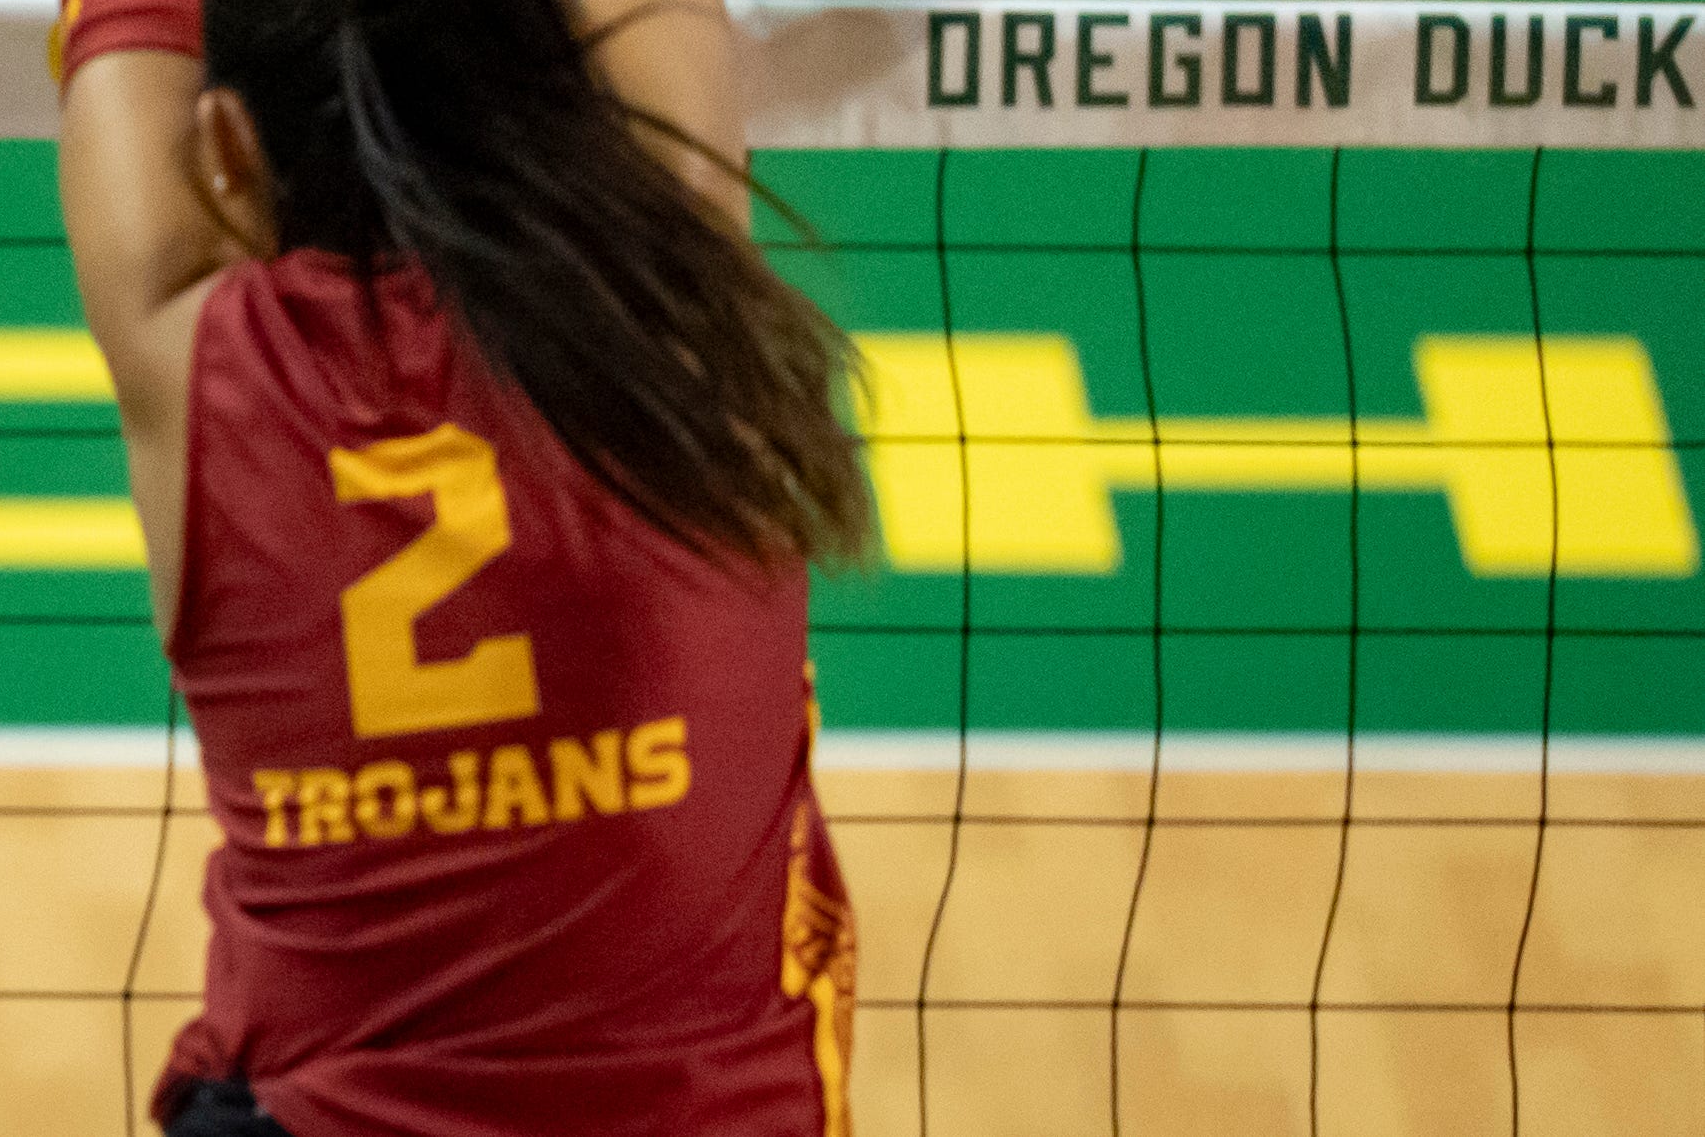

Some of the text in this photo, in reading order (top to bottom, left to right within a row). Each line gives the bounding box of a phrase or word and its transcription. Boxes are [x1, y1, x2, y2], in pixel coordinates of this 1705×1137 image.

[926, 11, 1699, 108] OREGON DUCK
[328, 421, 540, 739] 2
[252, 715, 693, 849] TROJANS
